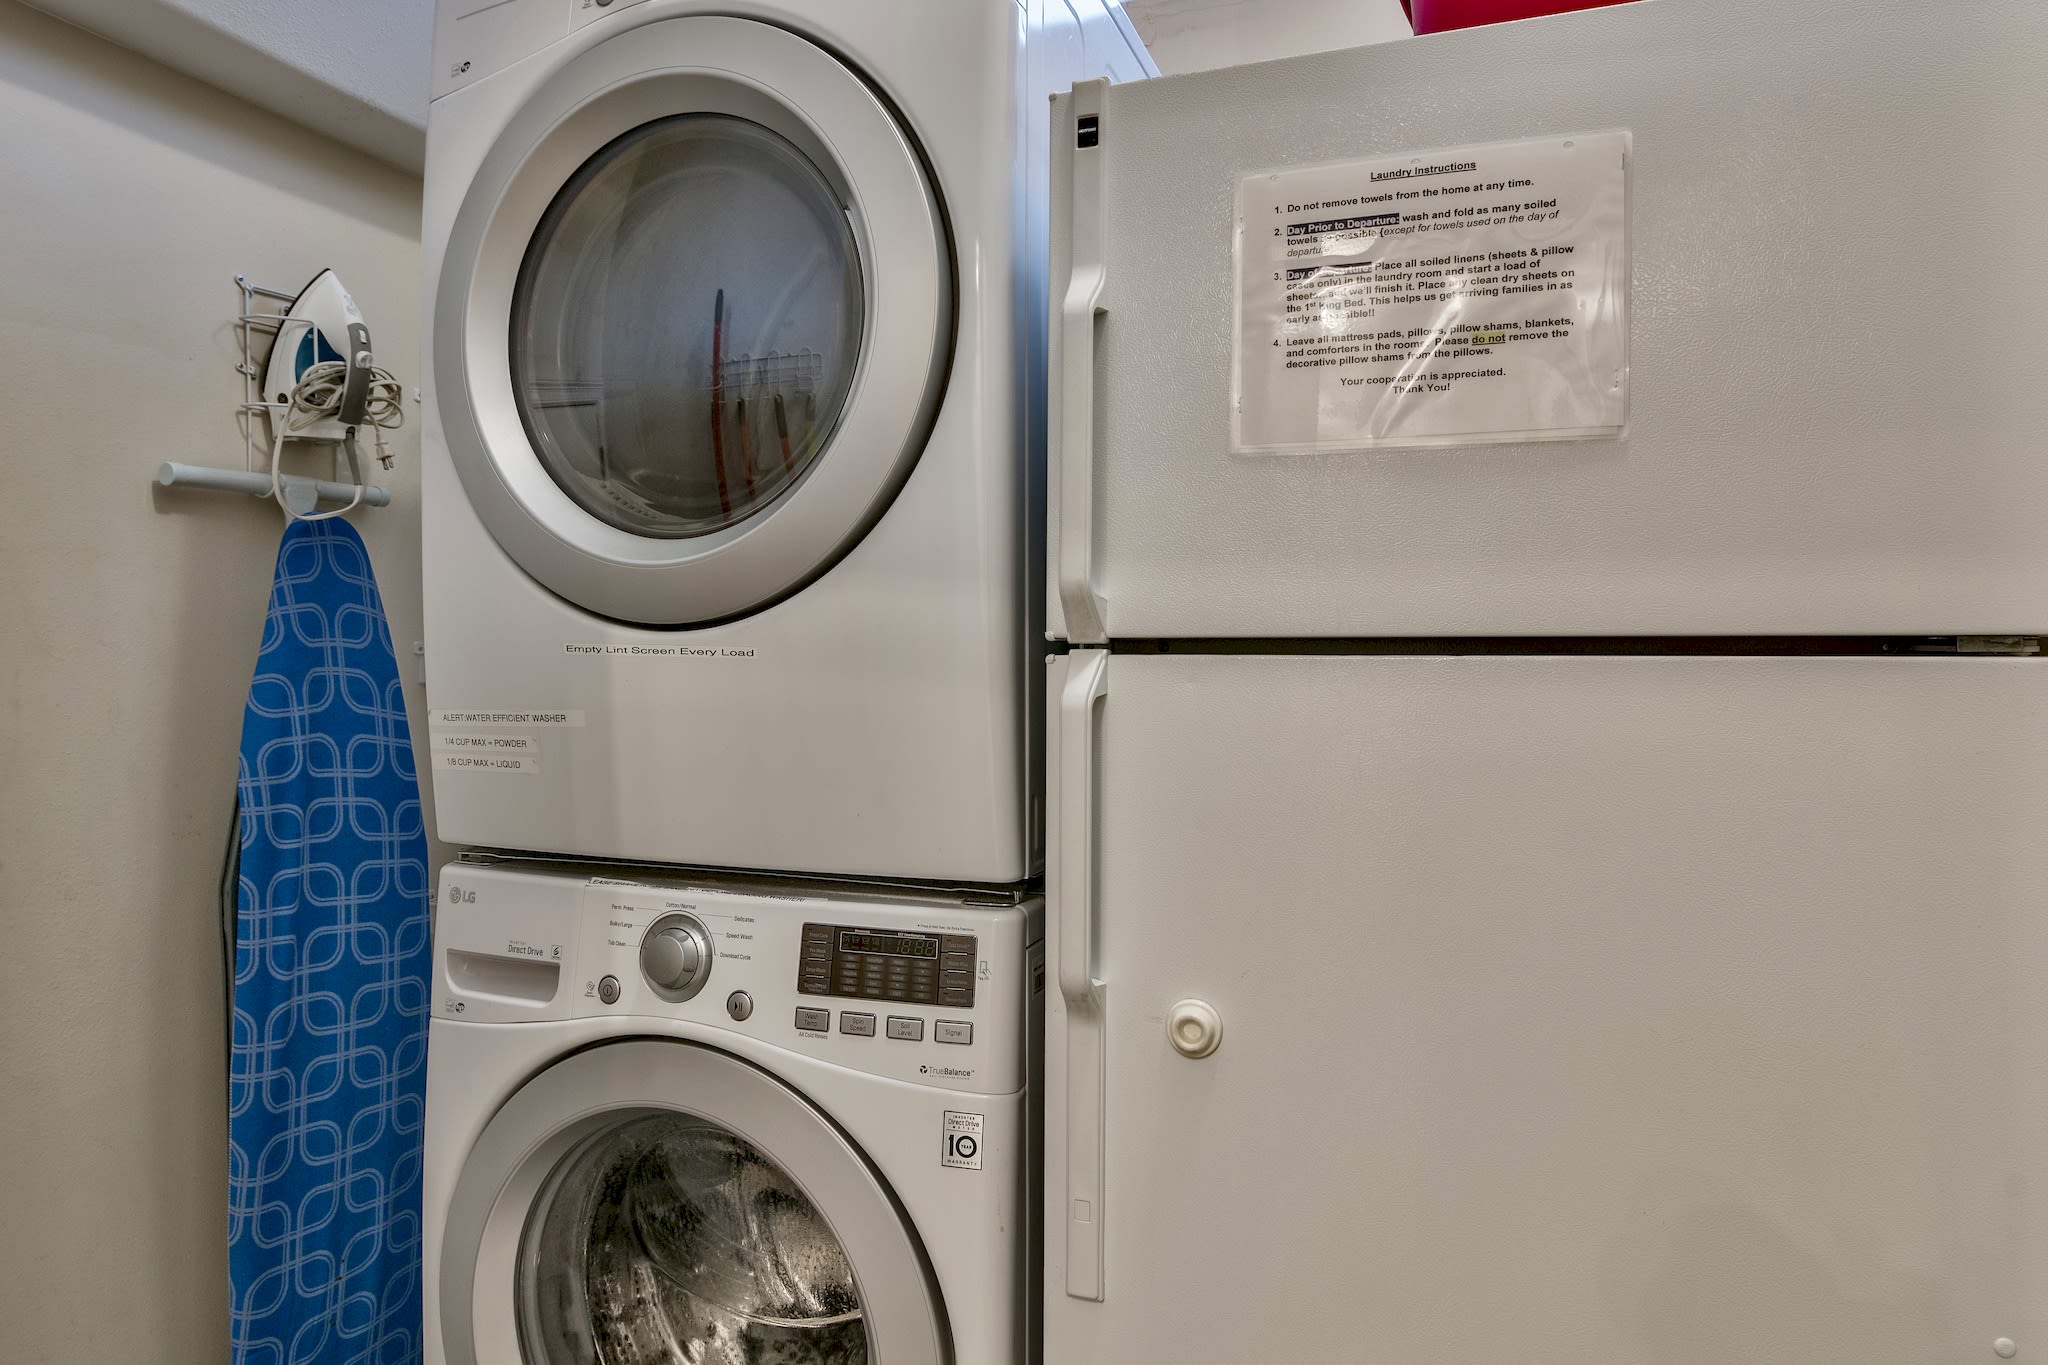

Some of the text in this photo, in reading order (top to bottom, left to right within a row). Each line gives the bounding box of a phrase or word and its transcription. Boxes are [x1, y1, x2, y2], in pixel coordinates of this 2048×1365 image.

[1370, 161, 1476, 181] Laundry Instructions
[1287, 204, 1301, 213] Do
[1303, 202, 1319, 210] not
[1322, 198, 1358, 208] remove
[1361, 193, 1393, 204] towels
[1396, 191, 1419, 200] from
[1422, 188, 1439, 197] the
[1442, 185, 1470, 195] home
[1473, 183, 1483, 192] at
[1486, 182, 1505, 191] any
[1508, 179, 1534, 188] time.
[1287, 226, 1306, 236] Day
[1308, 222, 1332, 232] Prior
[1335, 221, 1344, 230] to
[1347, 216, 1399, 229] Departure:
[1402, 212, 1429, 222] wash
[1432, 210, 1451, 219] and
[1454, 207, 1474, 217] fold
[1492, 203, 1521, 213] many
[1524, 198, 1556, 210] soiled
[1287, 235, 1318, 246] towels
[1417, 223, 1430, 232] for
[1433, 219, 1464, 231] towels
[1467, 217, 1491, 227] used
[1493, 216, 1506, 224] on
[1509, 214, 1524, 223] the
[1527, 212, 1546, 222] day
[1548, 210, 1560, 219] of
[1287, 271, 1305, 281] Day
[1375, 260, 1402, 271] Place
[1405, 259, 1417, 268] all
[1420, 256, 1451, 266] soiled
[1454, 253, 1485, 264] linens
[1488, 250, 1527, 262] (sheets
[1530, 248, 1538, 256] &
[1541, 246, 1574, 257] pillow
[1344, 277, 1353, 285] in
[1356, 275, 1372, 284] the
[1375, 272, 1413, 283] laundry
[1415, 270, 1442, 279] room
[1445, 267, 1464, 276] and
[1467, 264, 1492, 274] start
[1503, 261, 1526, 271] load
[1529, 259, 1541, 268] of
[1375, 282, 1402, 293] finish
[1405, 281, 1415, 290] it.
[1418, 280, 1446, 290] Place
[1470, 277, 1498, 285] clean
[1502, 274, 1519, 284] dry
[1522, 270, 1558, 281] sheets
[1561, 269, 1575, 277] on
[1287, 304, 1302, 313] the
[1305, 302, 1316, 311] 1st
[1344, 298, 1366, 307] Bed.
[1369, 295, 1391, 305] This
[1393, 293, 1421, 305] helps
[1424, 293, 1437, 301] us
[1502, 283, 1544, 295] families
[1547, 282, 1557, 291] in
[1287, 315, 1310, 324] early
[1273, 339, 1281, 347] 4.
[1286, 337, 1315, 346] Leave
[1317, 335, 1329, 344] all
[1331, 332, 1374, 342] mattress
[1377, 329, 1405, 341] pads,
[1450, 324, 1481, 335] pillow
[1483, 322, 1521, 332] shams,
[1525, 317, 1574, 328] blankets,
[1286, 348, 1304, 357] and
[1307, 344, 1360, 356] comforters
[1363, 343, 1372, 351] in
[1375, 341, 1391, 350] the
[1472, 335, 1485, 345] do
[1488, 333, 1506, 343] not
[1509, 330, 1549, 341] remove
[1552, 329, 1569, 338] the
[1286, 357, 1337, 369] decorative
[1339, 355, 1369, 367] pillow
[1371, 353, 1404, 362] shams
[1434, 348, 1450, 357] the
[1453, 347, 1493, 359] pillows.
[1341, 377, 1364, 386] Your
[1430, 371, 1438, 381] is
[1441, 368, 1506, 380] appreciated.
[1427, 383, 1450, 392] You!
[566, 645, 754, 657] Empty Lint Screen Every Load
[492, 714, 529, 722] EFFICIENT
[532, 714, 567, 723] WASHER
[455, 738, 470, 746] CUP
[471, 738, 486, 746] MAX
[494, 740, 527, 748] POWDER
[473, 759, 489, 767] MAX
[496, 760, 521, 769] LIQUID
[734, 915, 755, 923] Delicates
[726, 932, 740, 940] Speed
[508, 944, 544, 956] Direct Drive
[719, 952, 751, 961] Download Cycle
[852, 1018, 864, 1026] Spin
[900, 1022, 911, 1030] Soil
[849, 1024, 867, 1033] Speed
[897, 1029, 913, 1037] Level
[945, 1029, 963, 1038] Signal
[965, 1120, 980, 1128] Drive
[948, 1134, 977, 1159] 10
